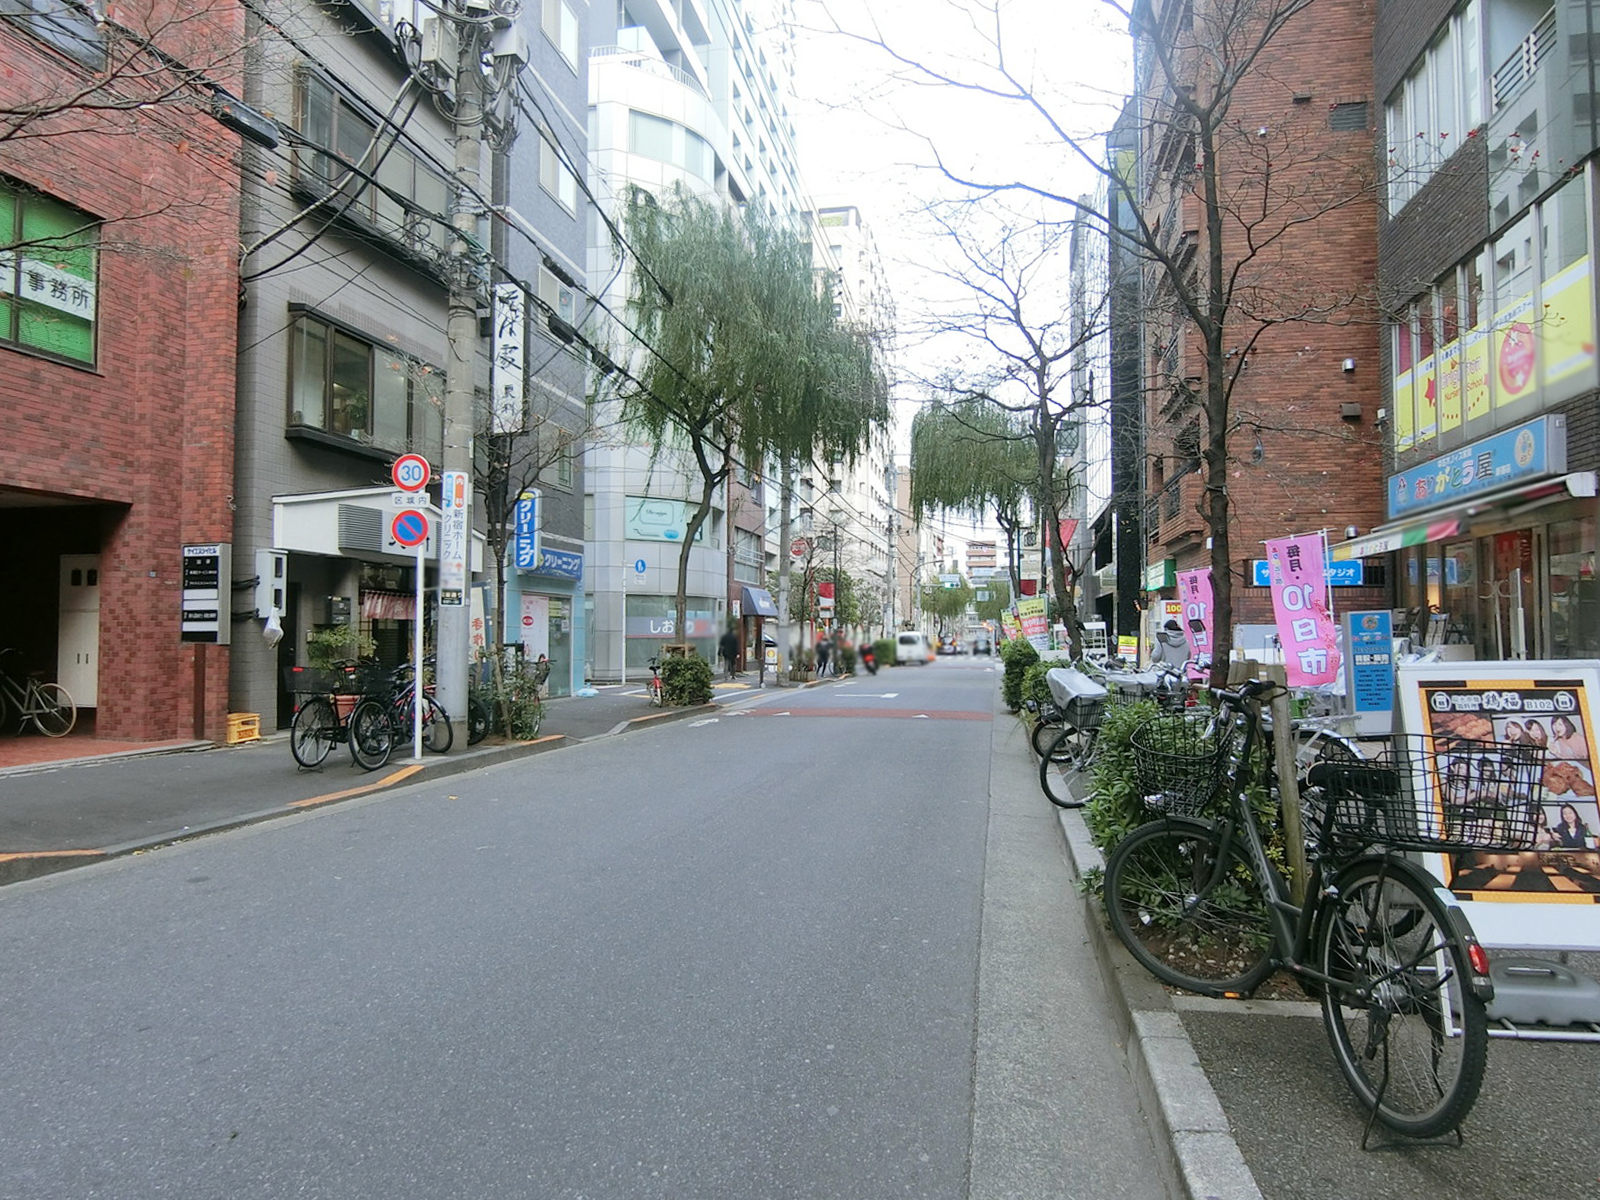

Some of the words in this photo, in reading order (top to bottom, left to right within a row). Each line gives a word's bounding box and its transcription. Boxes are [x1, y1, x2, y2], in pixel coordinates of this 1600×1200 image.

[28, 270, 90, 309] 事務所
[401, 465, 422, 481] 30
[1413, 451, 1494, 500] ありがとう屋
[394, 496, 427, 505] 区域内
[443, 514, 452, 560] クリニック
[452, 508, 464, 561] 新宿ホーム
[519, 500, 535, 566] クリーニング
[544, 553, 581, 571] クリーニング
[1526, 700, 1552, 710] B102
